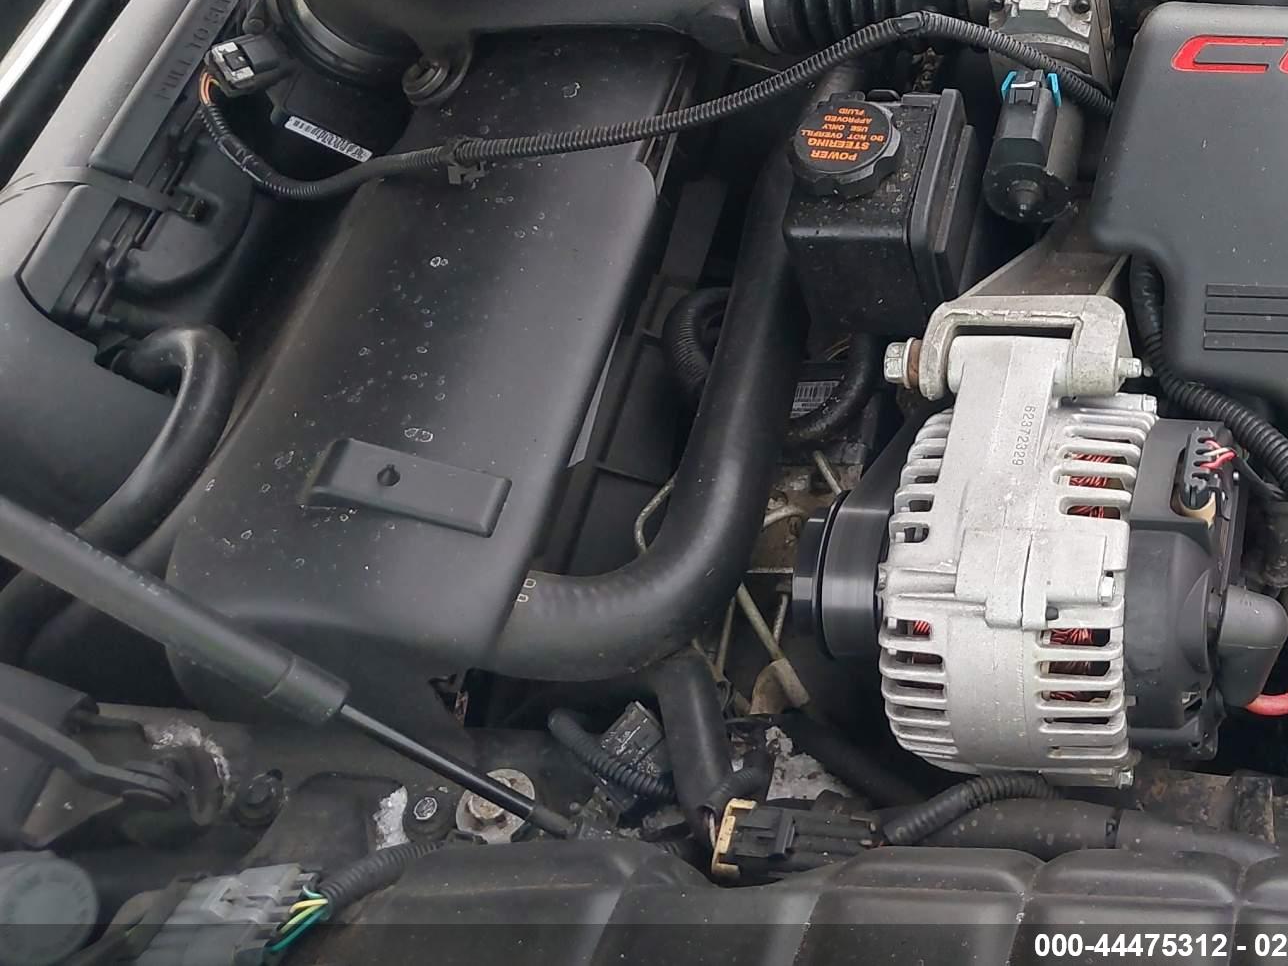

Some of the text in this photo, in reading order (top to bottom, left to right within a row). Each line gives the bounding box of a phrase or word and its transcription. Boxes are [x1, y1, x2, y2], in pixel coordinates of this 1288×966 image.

[838, 108, 865, 116] FLUID
[824, 115, 873, 124] APPROVED
[822, 123, 845, 131] ONLY
[801, 129, 843, 139] OVERFILL
[807, 137, 870, 150] STEERING
[810, 150, 858, 161] POWER
[1012, 405, 1036, 466] 62372329
